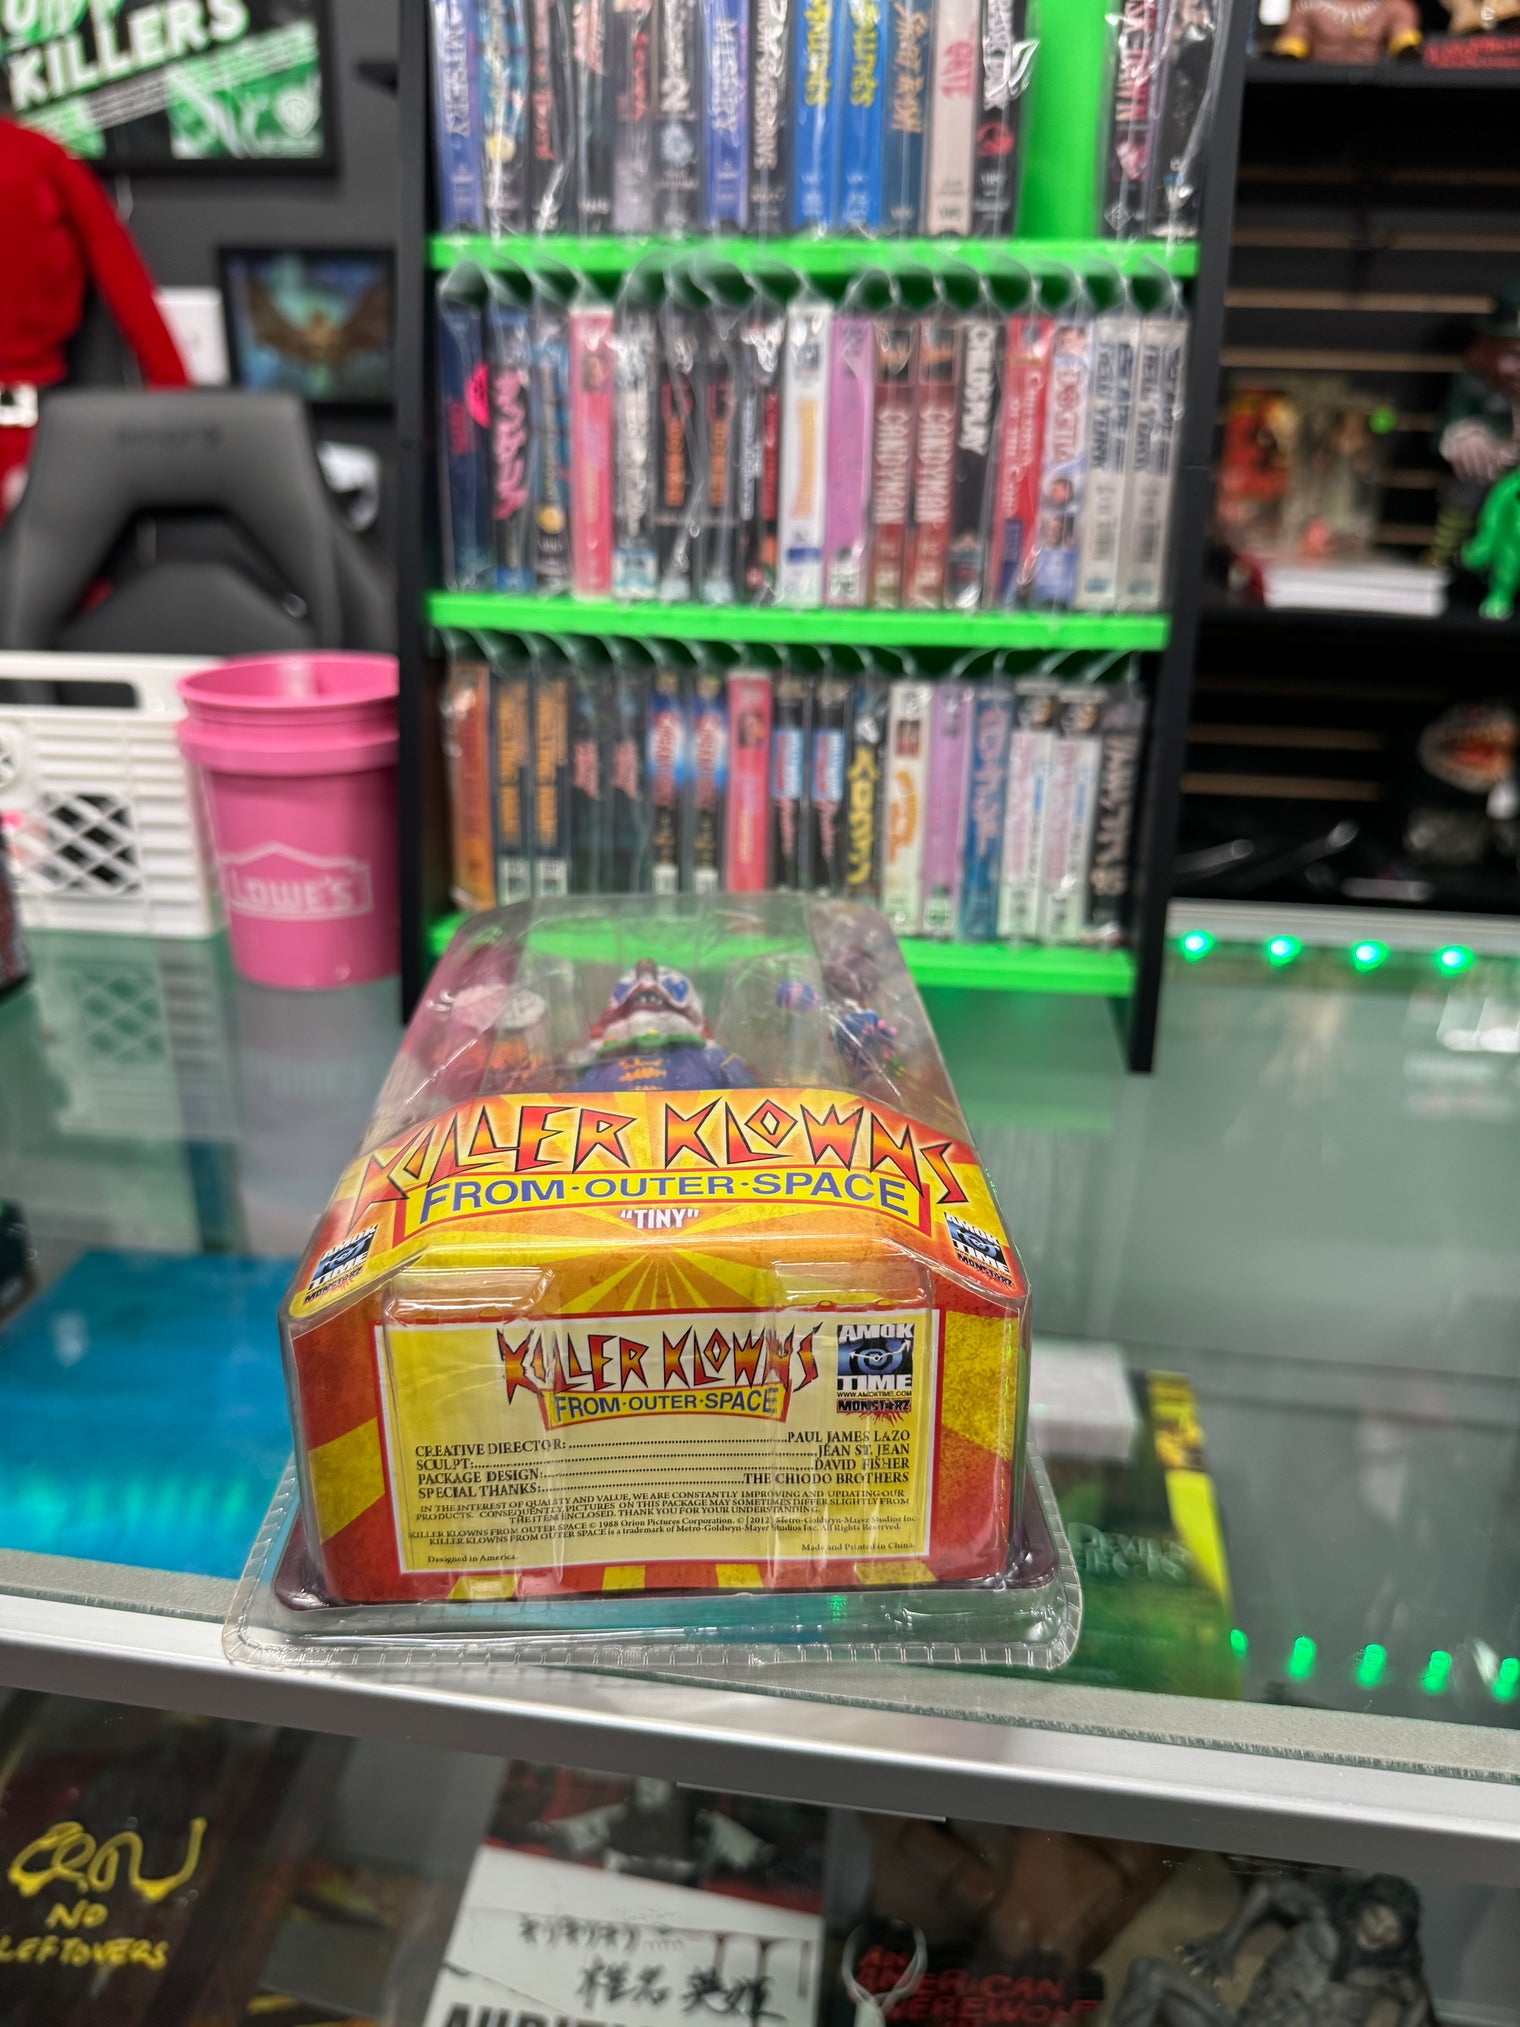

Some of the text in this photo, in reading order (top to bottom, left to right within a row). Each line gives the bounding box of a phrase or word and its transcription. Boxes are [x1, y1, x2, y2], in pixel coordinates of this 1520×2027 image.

[9, 0, 248, 112] KILLERS
[957, 402, 992, 455] PLAY
[874, 410, 911, 523] CANDYMAN
[915, 408, 955, 523] CANDYMAN
[228, 868, 356, 908] LOWE'S
[345, 1097, 969, 1238] KILLER KLOWNS
[419, 1171, 910, 1225] FROM OUTER SPACE
[307, 1250, 369, 1292] TIME
[953, 1240, 1011, 1276] TIME
[838, 1323, 915, 1345] AMOK
[496, 1321, 823, 1405] KILLER KLOWNS
[837, 1375, 913, 1391] TIME
[554, 1387, 780, 1422] FROM OUTER SPACE
[415, 1444, 485, 1457] CREATIVE
[788, 1431, 822, 1443] PAUL
[827, 1431, 870, 1444] JAMES
[874, 1430, 911, 1442] LAZO
[818, 1445, 851, 1458] JEAN
[855, 1445, 873, 1456] ST.
[877, 1444, 911, 1457] JEAN
[418, 1472, 482, 1486] PACKAGE
[814, 1459, 856, 1471] DAVID
[862, 1457, 910, 1470] FISHER
[418, 1485, 477, 1499] SPECIAL
[744, 1473, 771, 1485] THE
[775, 1473, 832, 1485] CHIODO
[836, 1471, 910, 1484] BROTHERS
[420, 1489, 905, 1513] IN THE INTEREST OF QUALITY AND VALUE, WE ARE CONSTANTLY IMPROVING AND UPDATING OUR
[509, 1515, 532, 1525] THE
[533, 1514, 559, 1523] ITEM
[618, 1508, 655, 1517] THANK
[656, 1507, 678, 1515] YOU
[679, 1506, 700, 1515] FOR
[701, 1505, 730, 1514] YOUR
[566, 1502, 615, 1512] PICTURES
[619, 1500, 635, 1509] ON
[636, 1499, 660, 1508] THIS
[662, 1499, 708, 1508] PACKAGE
[709, 1498, 731, 1506] MAY
[732, 1498, 792, 1507] SOMETIMES
[793, 1498, 828, 1507] DIFFER
[829, 1498, 878, 1506] SLIGHTLY
[879, 1497, 910, 1505] FROM
[409, 1530, 445, 1539] KILLER
[447, 1529, 488, 1538] KLOWNS
[490, 1527, 519, 1537] FROM
[521, 1524, 555, 1533] OUTER
[558, 1522, 587, 1531] SPACE
[599, 1520, 619, 1529] 1988
[620, 1519, 645, 1527] Orion
[647, 1518, 680, 1527] Pictures
[429, 1536, 464, 1545] KILLER
[466, 1535, 508, 1544] KLOWNS
[510, 1533, 539, 1542] FROM
[541, 1531, 575, 1540] OUTER
[577, 1529, 607, 1537] SPACE
[608, 1527, 615, 1535] is
[622, 1525, 665, 1534] trademark
[666, 1524, 675, 1532] of
[676, 1523, 769, 1533] Metro-Goldwyn-Mayer
[770, 1523, 801, 1532] Studios
[834, 1523, 860, 1533] Rights
[428, 1555, 467, 1564] Designed
[802, 1543, 825, 1551] Made
[826, 1543, 842, 1551] and
[844, 1542, 875, 1550] Printed
[46, 1901, 108, 1928] NO
